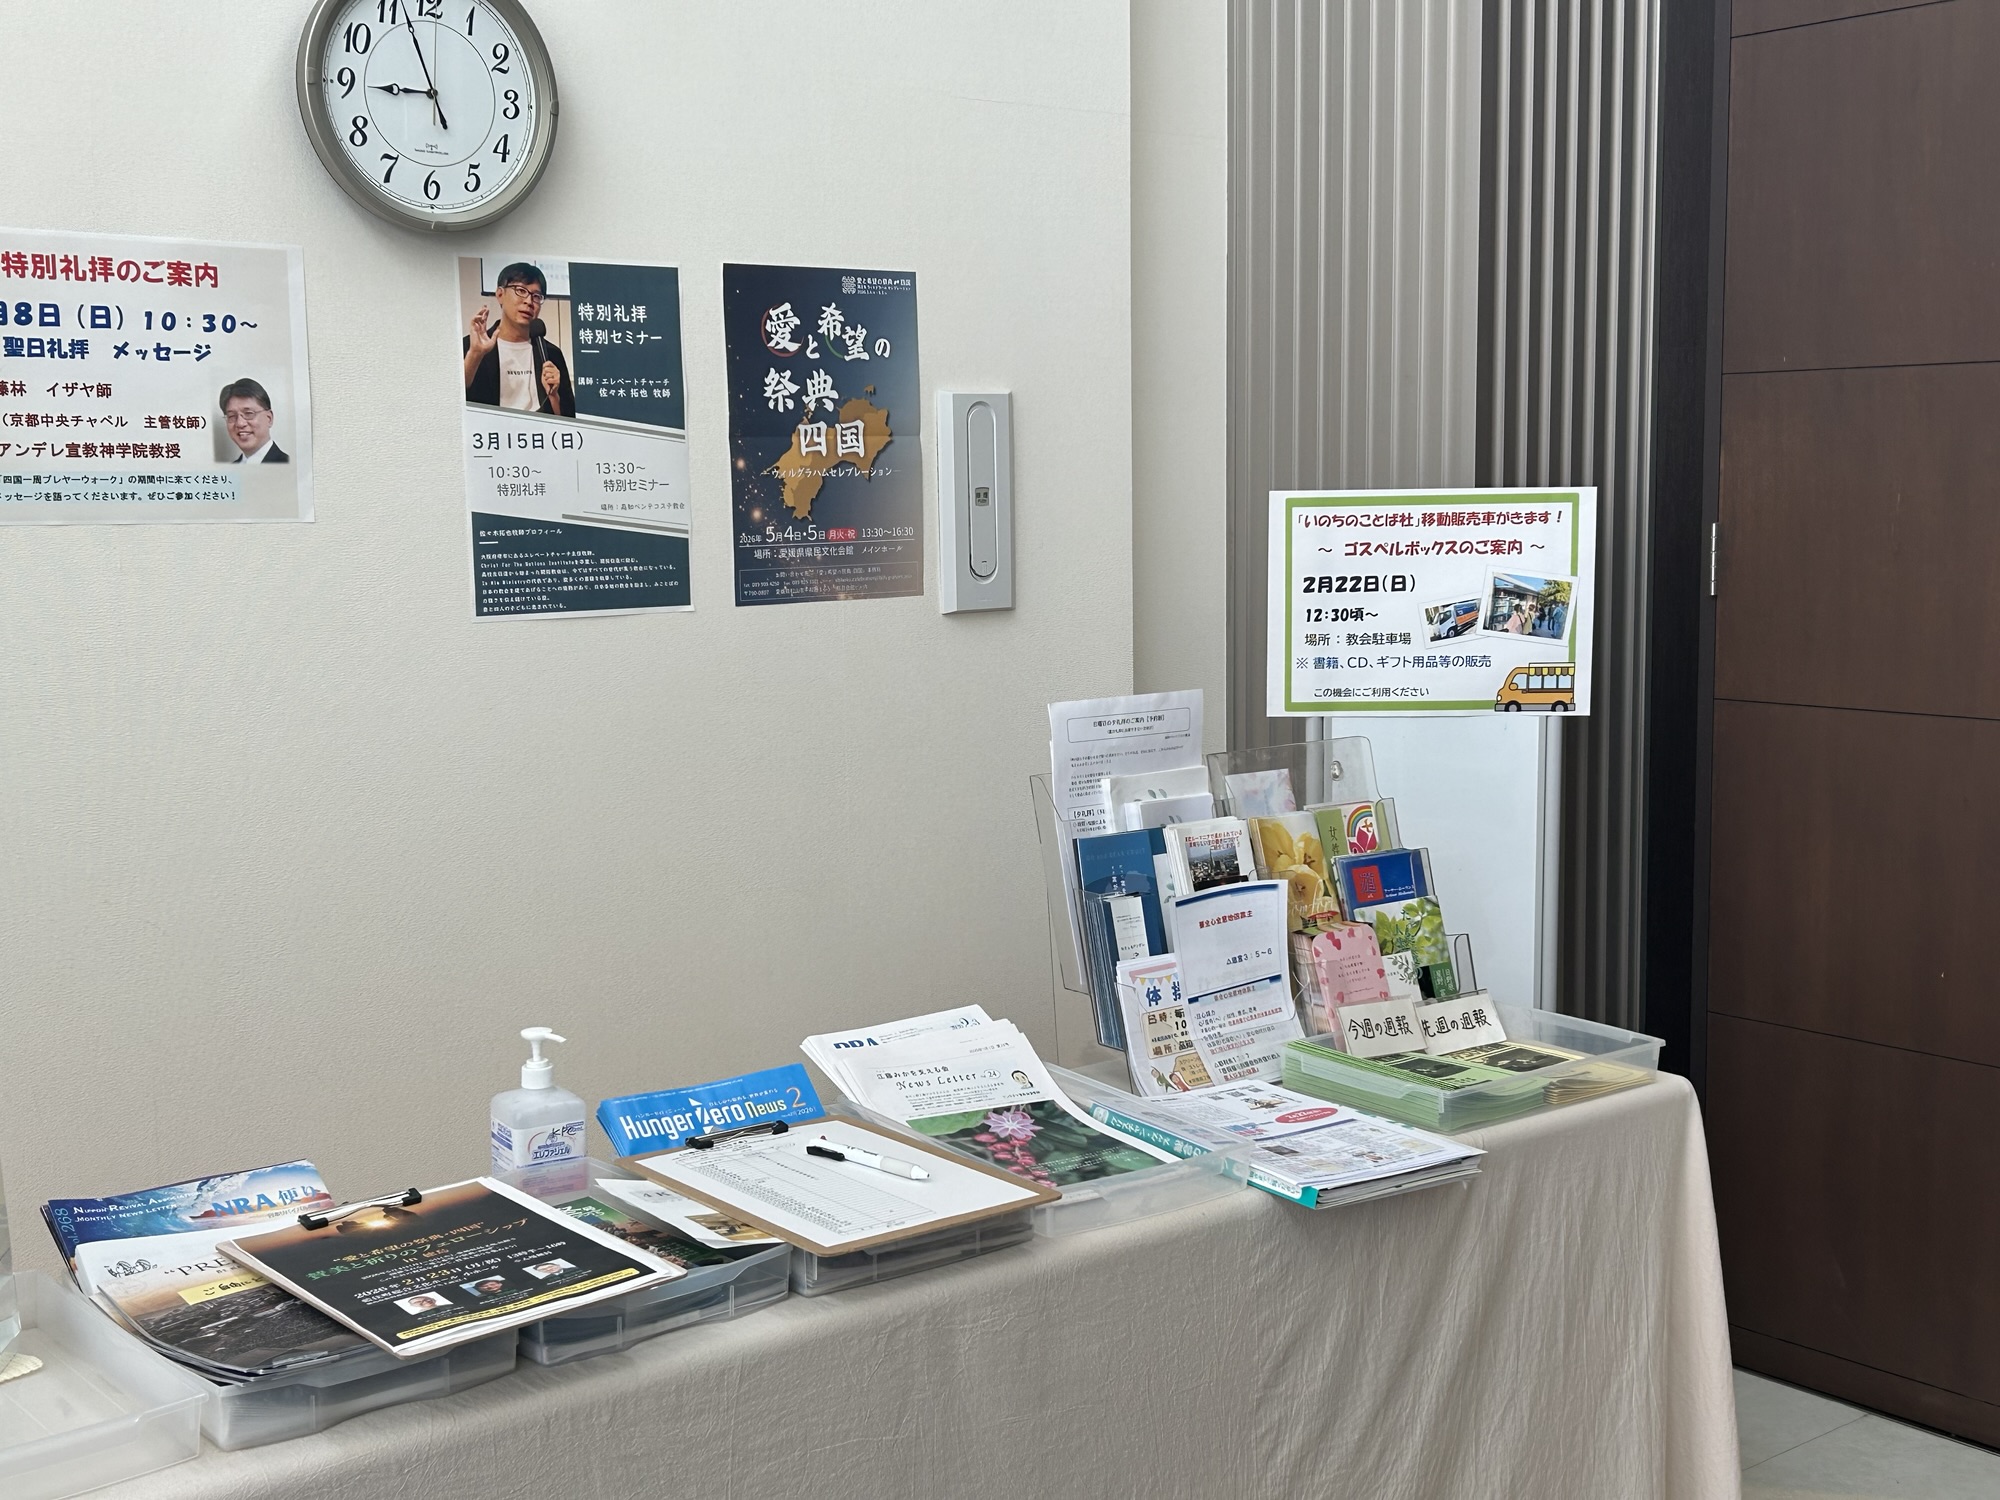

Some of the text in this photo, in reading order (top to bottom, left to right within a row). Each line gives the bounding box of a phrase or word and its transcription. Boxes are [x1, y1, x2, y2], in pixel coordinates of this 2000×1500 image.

[378, 0, 397, 24] 11
[416, 0, 443, 19] 12
[466, 6, 475, 36] 1
[343, 22, 371, 54] 10
[491, 43, 510, 74] 2
[337, 66, 356, 99] 9
[502, 89, 520, 119] 3
[349, 115, 368, 147] 8
[493, 134, 511, 163] 4
[380, 153, 399, 183] 7
[464, 163, 481, 192] 5
[423, 170, 441, 200] 6
[1, 250, 219, 288] 特別礼拝のご案内
[577, 302, 648, 323] 特別礼拝
[579, 328, 663, 345] 特別セミナー
[764, 302, 891, 362] 愛と希望の
[2, 336, 212, 362] 聖日礼拝 メッセージ
[46, 382, 113, 399] イザヤ師
[599, 388, 626, 398] 佐々木
[763, 367, 839, 413] 祭典
[797, 419, 865, 457] 四国
[497, 483, 546, 497] 特別礼拝
[603, 479, 670, 493] 特別セミナー
[1344, 539, 1523, 557] ゴスペルボックスのご案内
[1303, 574, 1417, 594] 2月22日(日)
[1313, 654, 1492, 671] 書籍、CD、ギフト用品等の販売
[1314, 687, 1430, 698] この機会にご利用ください
[1348, 1015, 1413, 1040] 今週の週報
[896, 1080, 931, 1091] News
[937, 1073, 977, 1085] Letter
[619, 1111, 695, 1140] Hunger
[744, 1099, 787, 1119] News
[786, 1087, 806, 1108] 2
